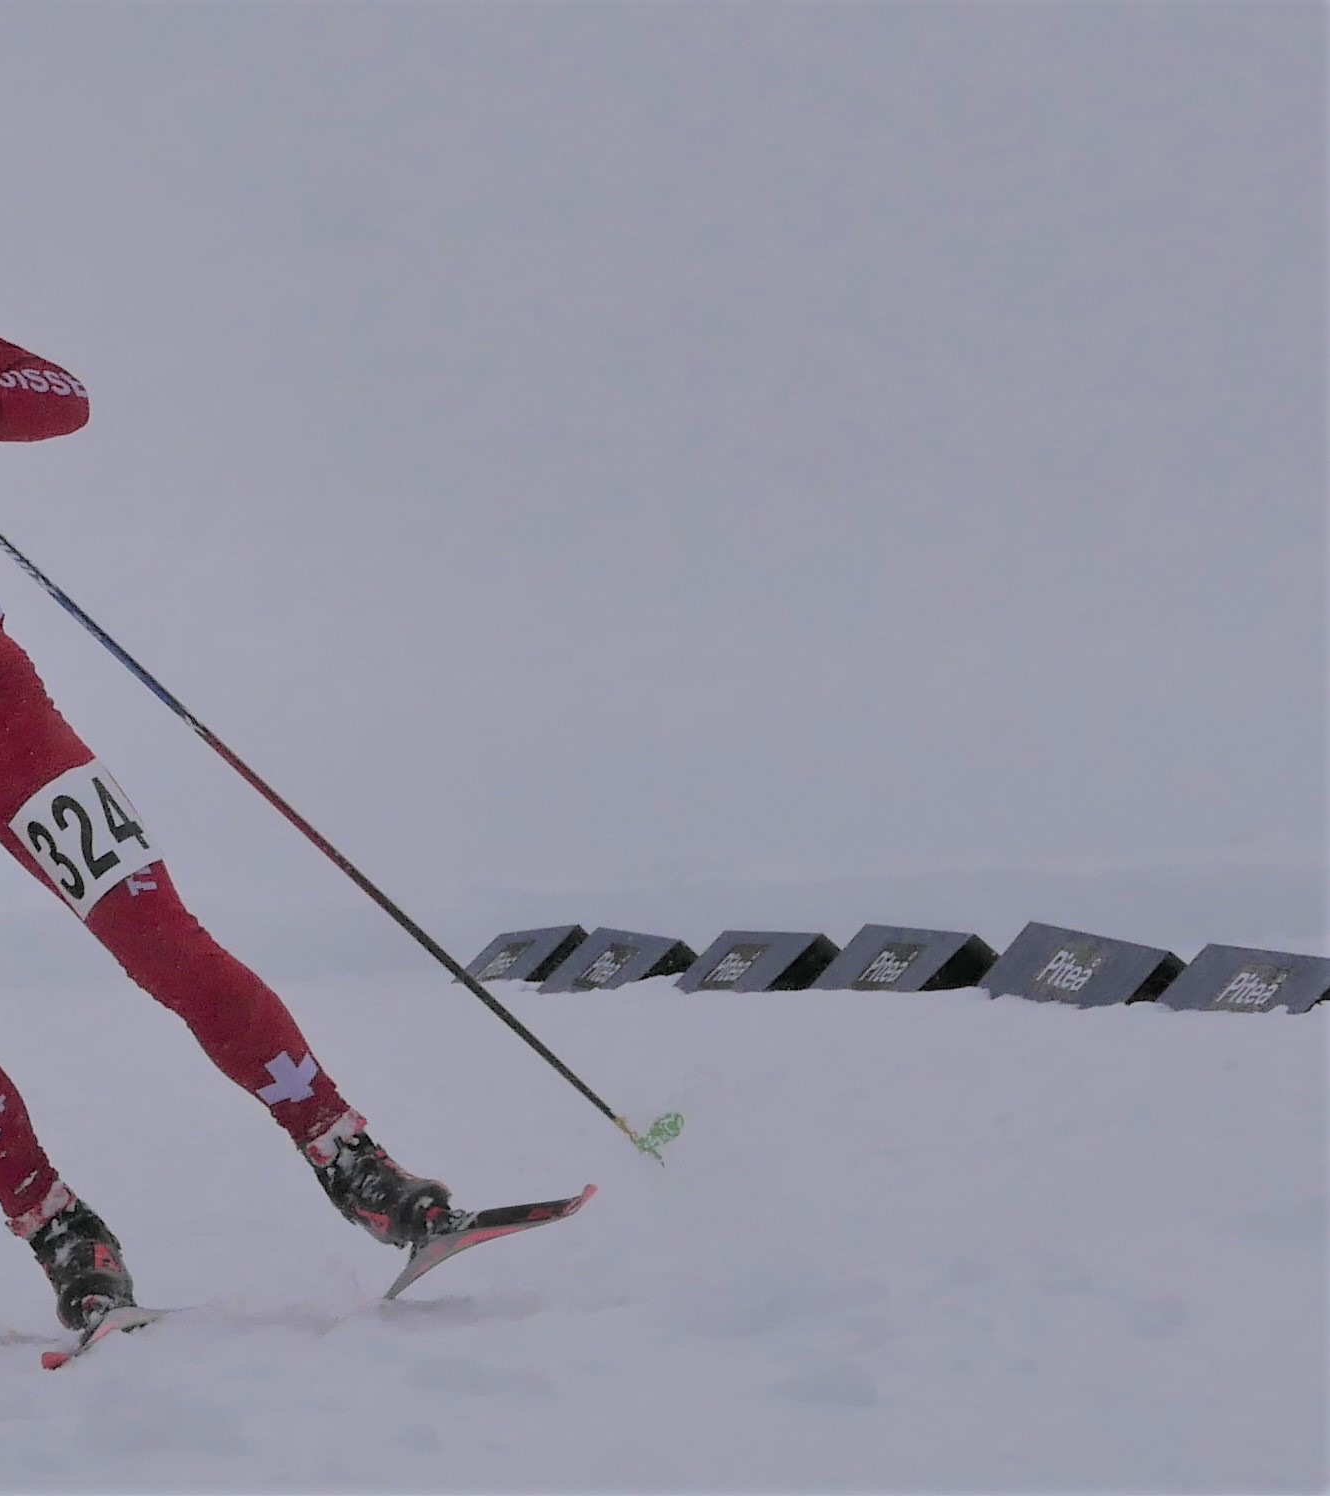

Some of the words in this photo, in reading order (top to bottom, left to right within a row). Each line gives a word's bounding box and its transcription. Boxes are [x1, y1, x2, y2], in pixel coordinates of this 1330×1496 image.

[27, 777, 150, 900] 324
[1036, 949, 1102, 991] Piteå
[1215, 971, 1288, 1005] Piteå
